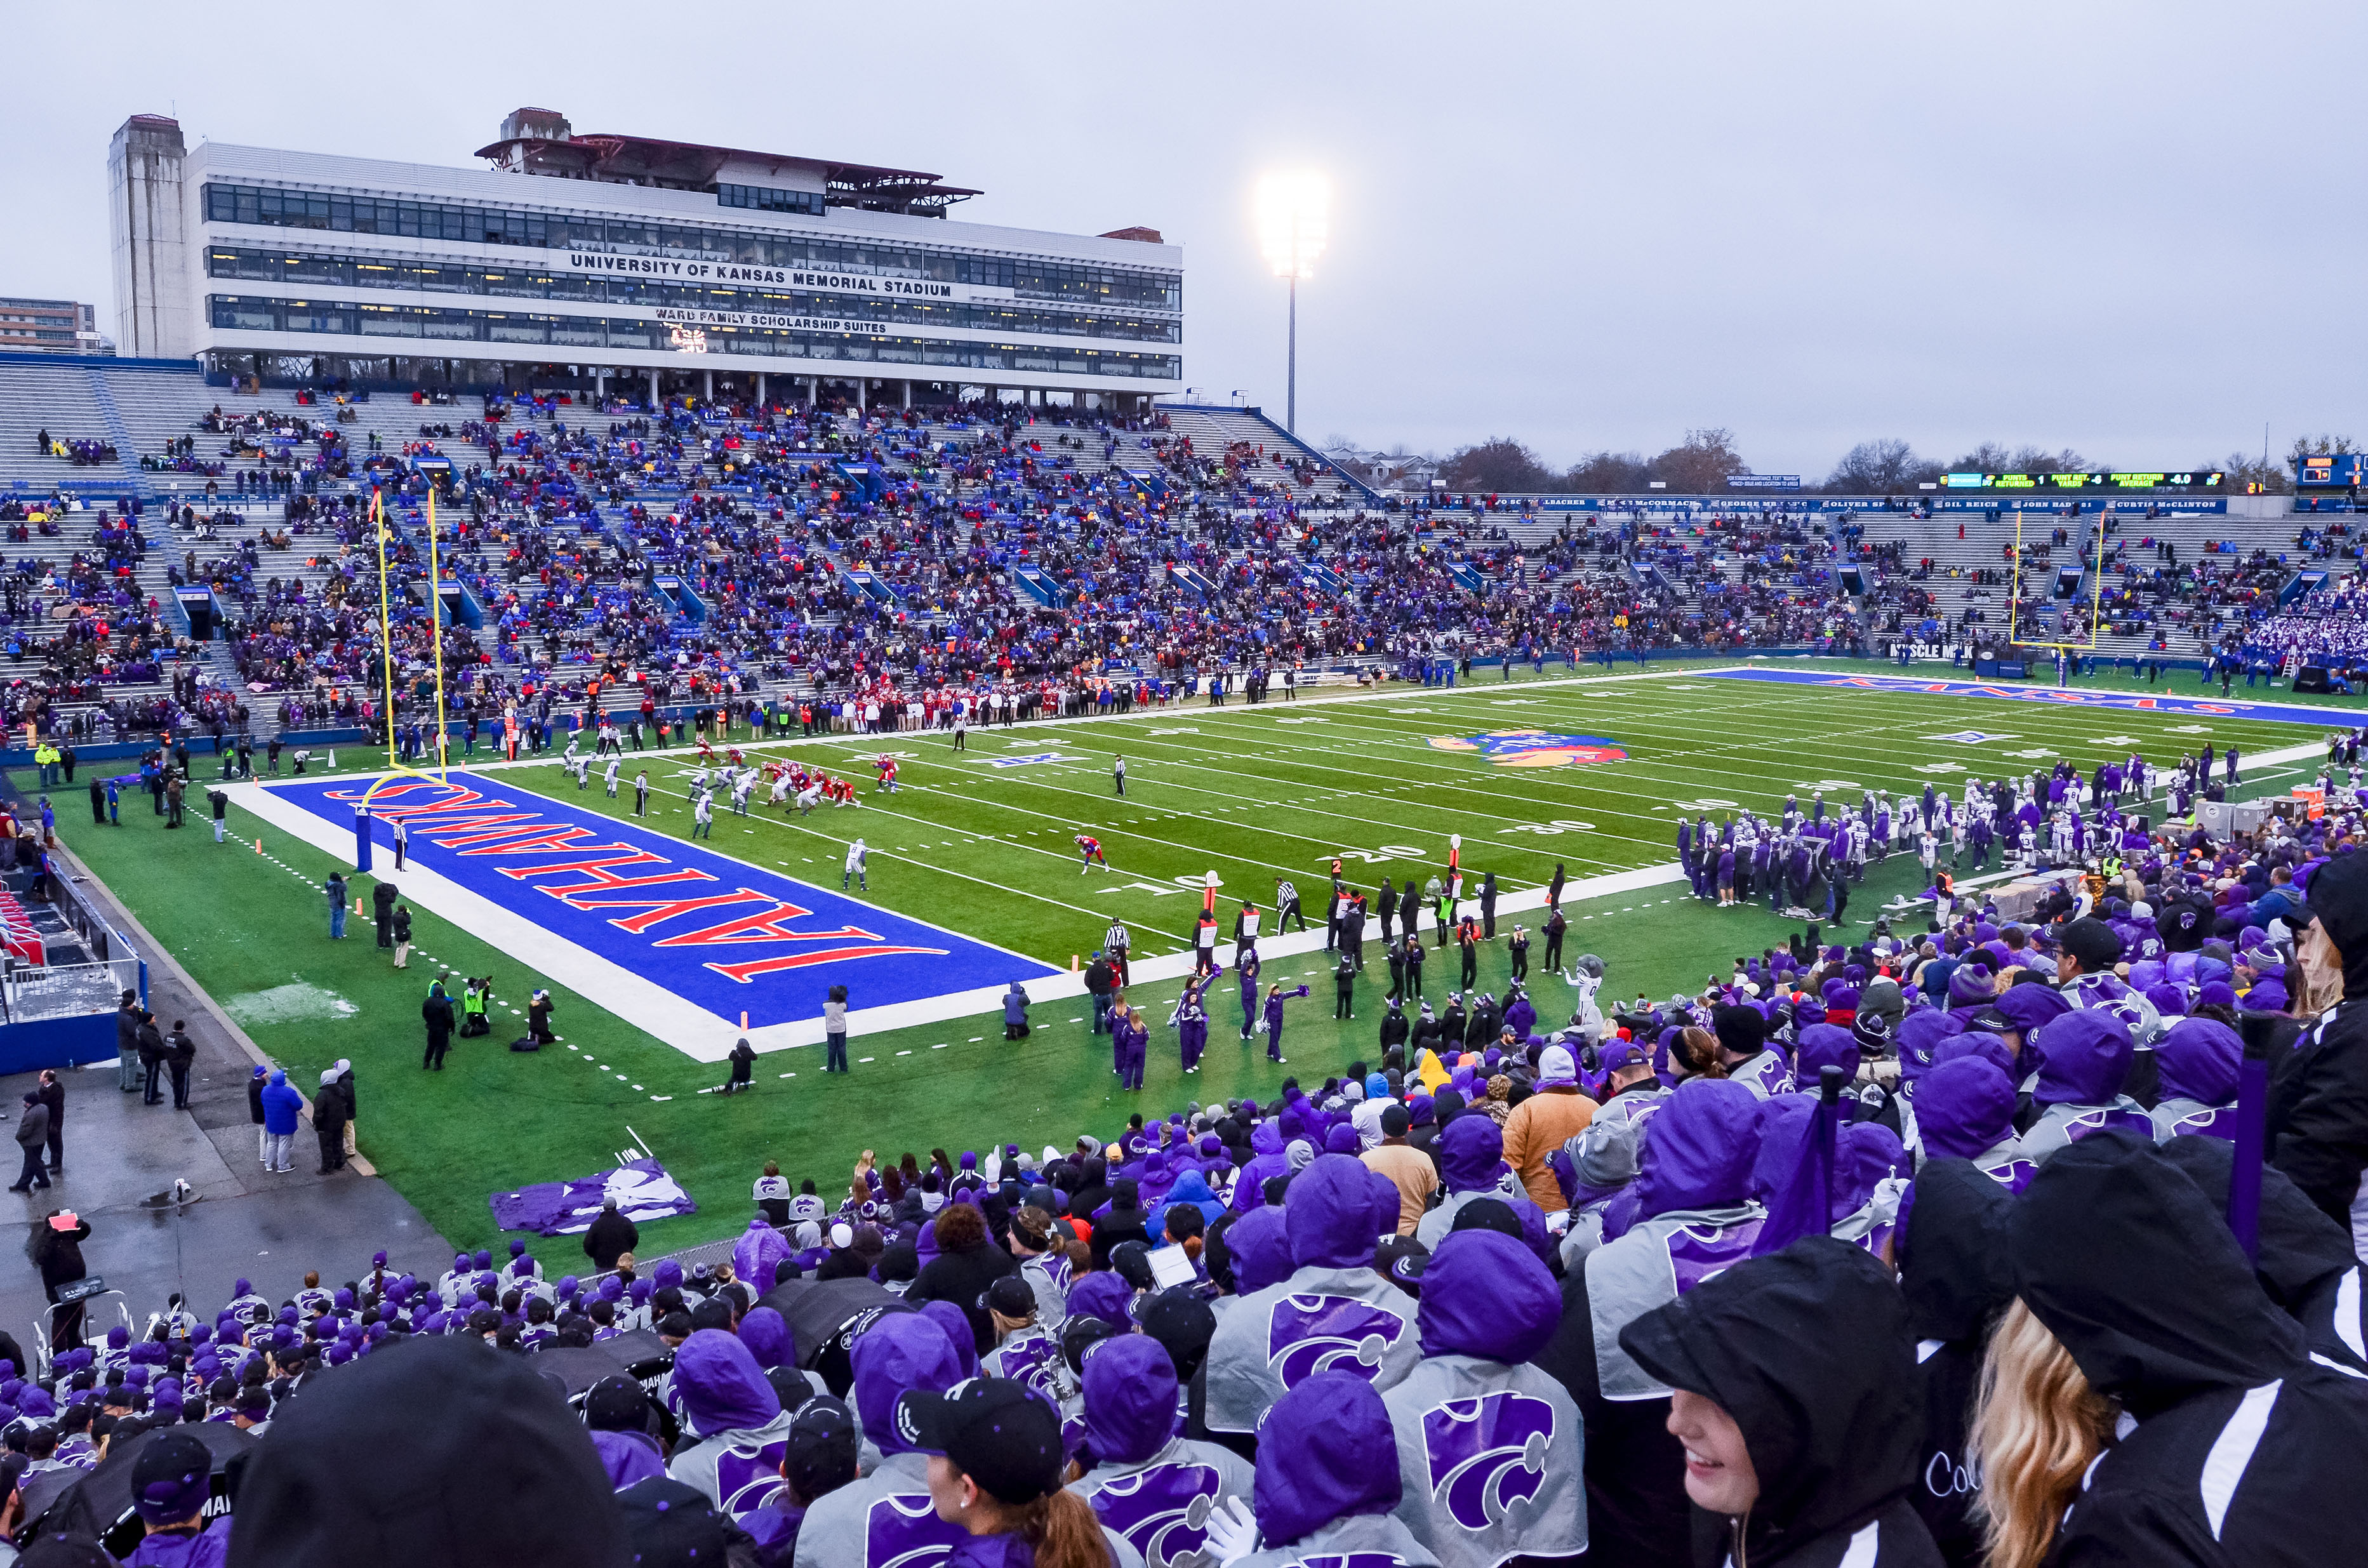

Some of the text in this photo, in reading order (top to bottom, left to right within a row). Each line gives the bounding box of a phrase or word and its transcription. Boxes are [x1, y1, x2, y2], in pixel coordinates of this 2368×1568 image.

[571, 254, 951, 296] UNIVERSITY OF KANSAS MEMORIAL STADIUM
[656, 309, 886, 333] WARD FAMILY SCHOLARSHIP SUITES
[2038, 475, 2044, 485] 1
[2091, 475, 2102, 484] -6
[2170, 474, 2192, 484] -6.0
[2247, 482, 2263, 495] 21
[1890, 643, 1939, 658] MSCLE
[1814, 678, 2254, 715] KANSAS
[1792, 780, 1861, 792] 50
[1673, 799, 1739, 811] 40
[1515, 820, 1596, 835] 30
[1855, 836, 1863, 845] 23
[2021, 838, 2030, 846] 13
[1339, 846, 1427, 863] 20
[1333, 860, 1341, 873] 2
[323, 781, 951, 985] JAYHAWKS
[1121, 875, 1225, 896] 10
[1589, 986, 1597, 997] 0
